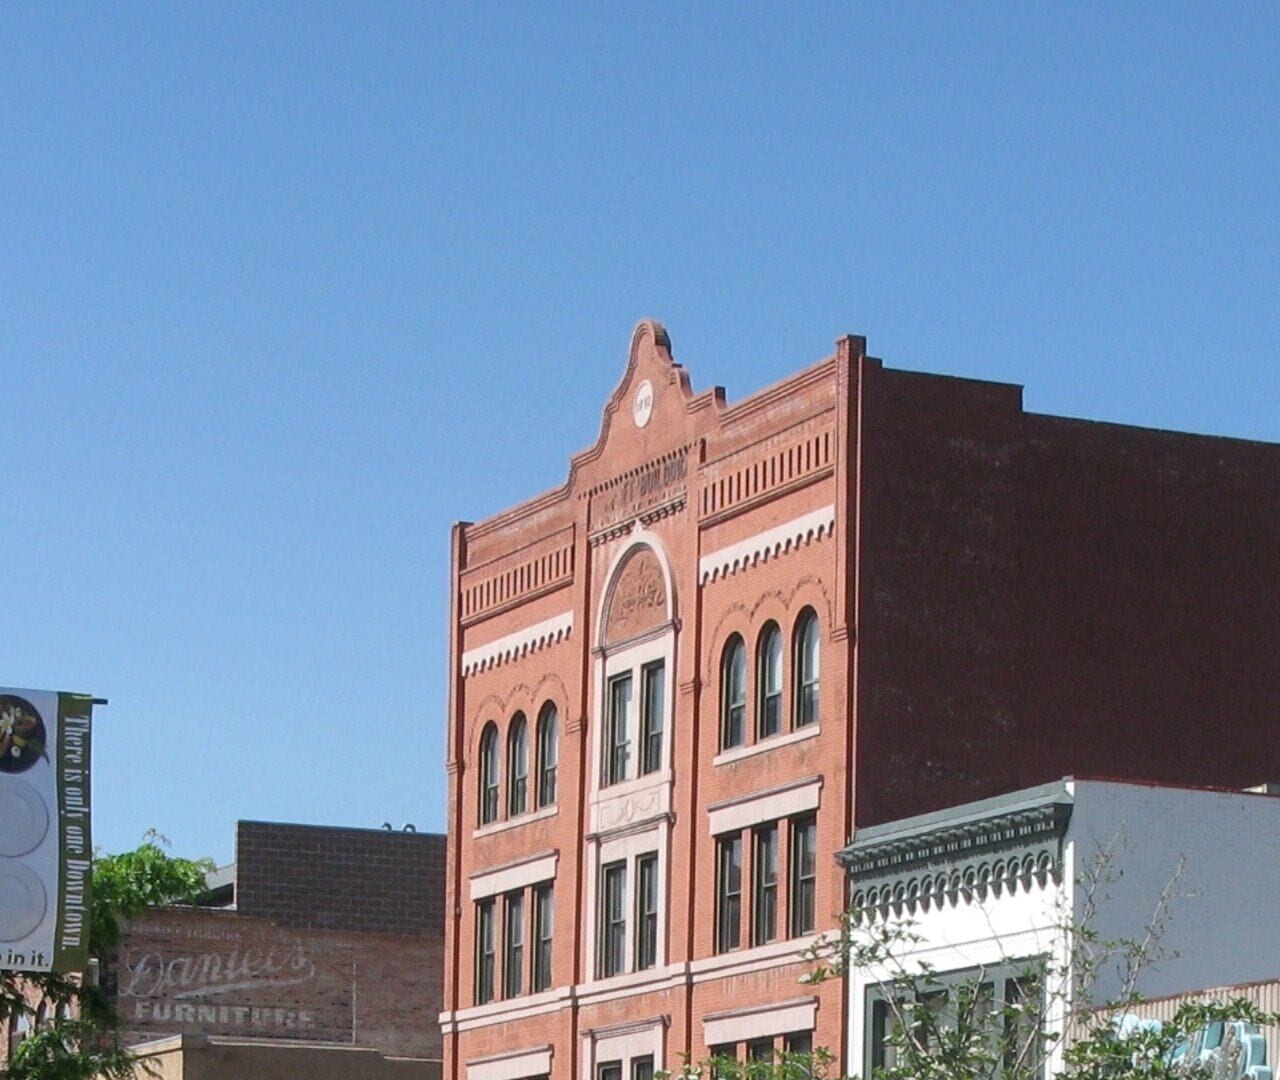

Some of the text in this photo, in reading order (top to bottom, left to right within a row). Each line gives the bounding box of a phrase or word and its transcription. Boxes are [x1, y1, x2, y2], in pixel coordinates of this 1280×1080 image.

[61, 715, 91, 950] There is only one Downtown.
[7, 949, 25, 965] in
[31, 950, 49, 967] it.
